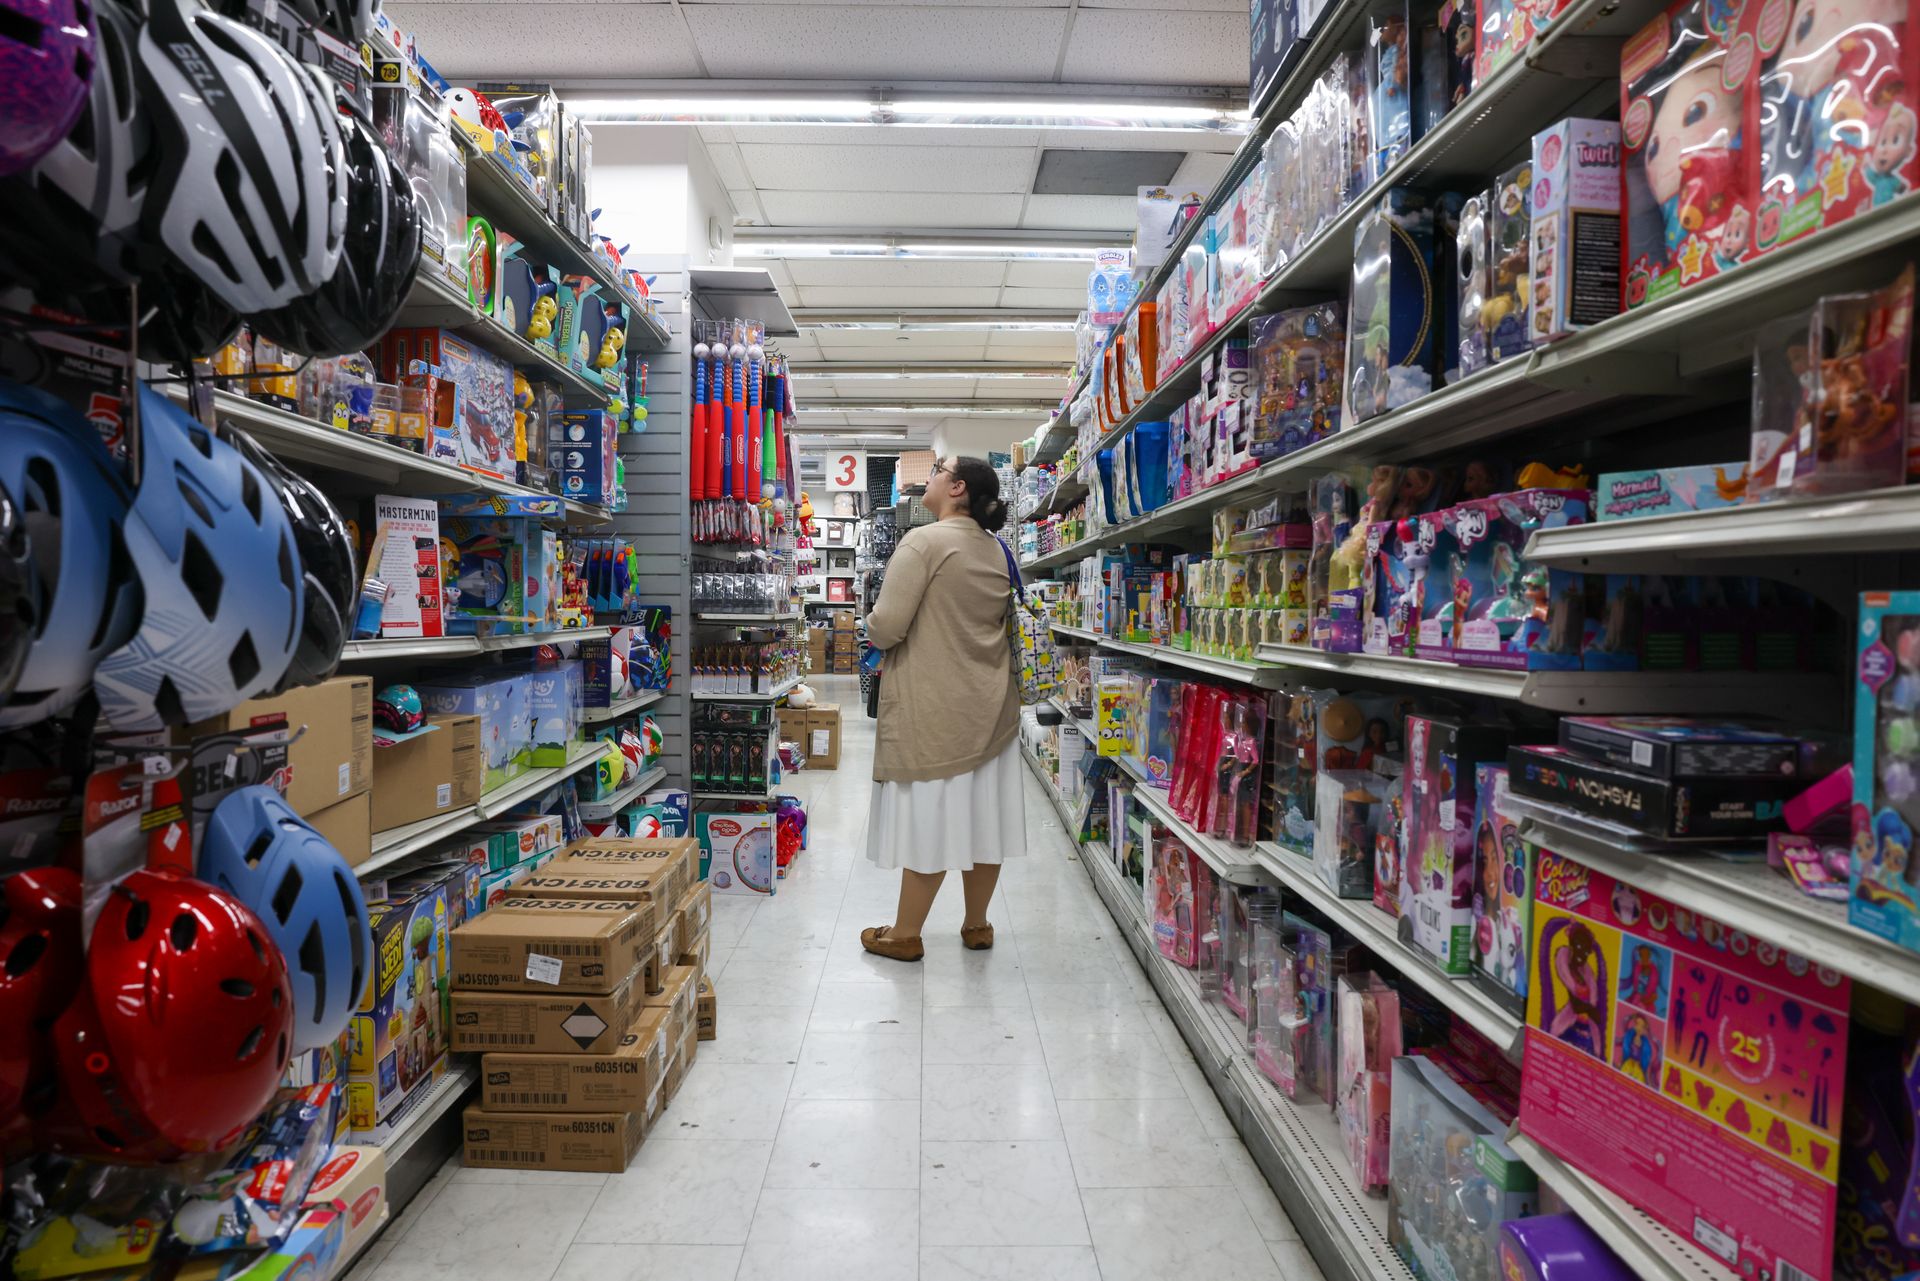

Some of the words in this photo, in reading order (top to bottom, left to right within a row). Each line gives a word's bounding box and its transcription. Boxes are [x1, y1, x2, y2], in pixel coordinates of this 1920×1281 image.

[168, 42, 226, 107] BELL
[383, 68, 397, 77] 739
[561, 301, 576, 347] PICKLEBALL
[835, 455, 857, 486] 3
[1611, 475, 1661, 499] Mermaid
[379, 506, 436, 521] MASTERMIND
[193, 759, 249, 793] BELL
[7, 798, 65, 813] Razor
[100, 794, 140, 816] Razor
[1579, 778, 1642, 811] FASHION
[568, 849, 670, 860] 60351CN
[521, 877, 650, 889] 60351CN
[503, 900, 642, 911] 60351CN
[383, 941, 402, 979] JEDI
[1730, 1031, 1762, 1063] 25
[594, 1062, 638, 1074] 60351CN
[572, 1121, 615, 1134] 60351CN
[1475, 1142, 1486, 1166] 3
